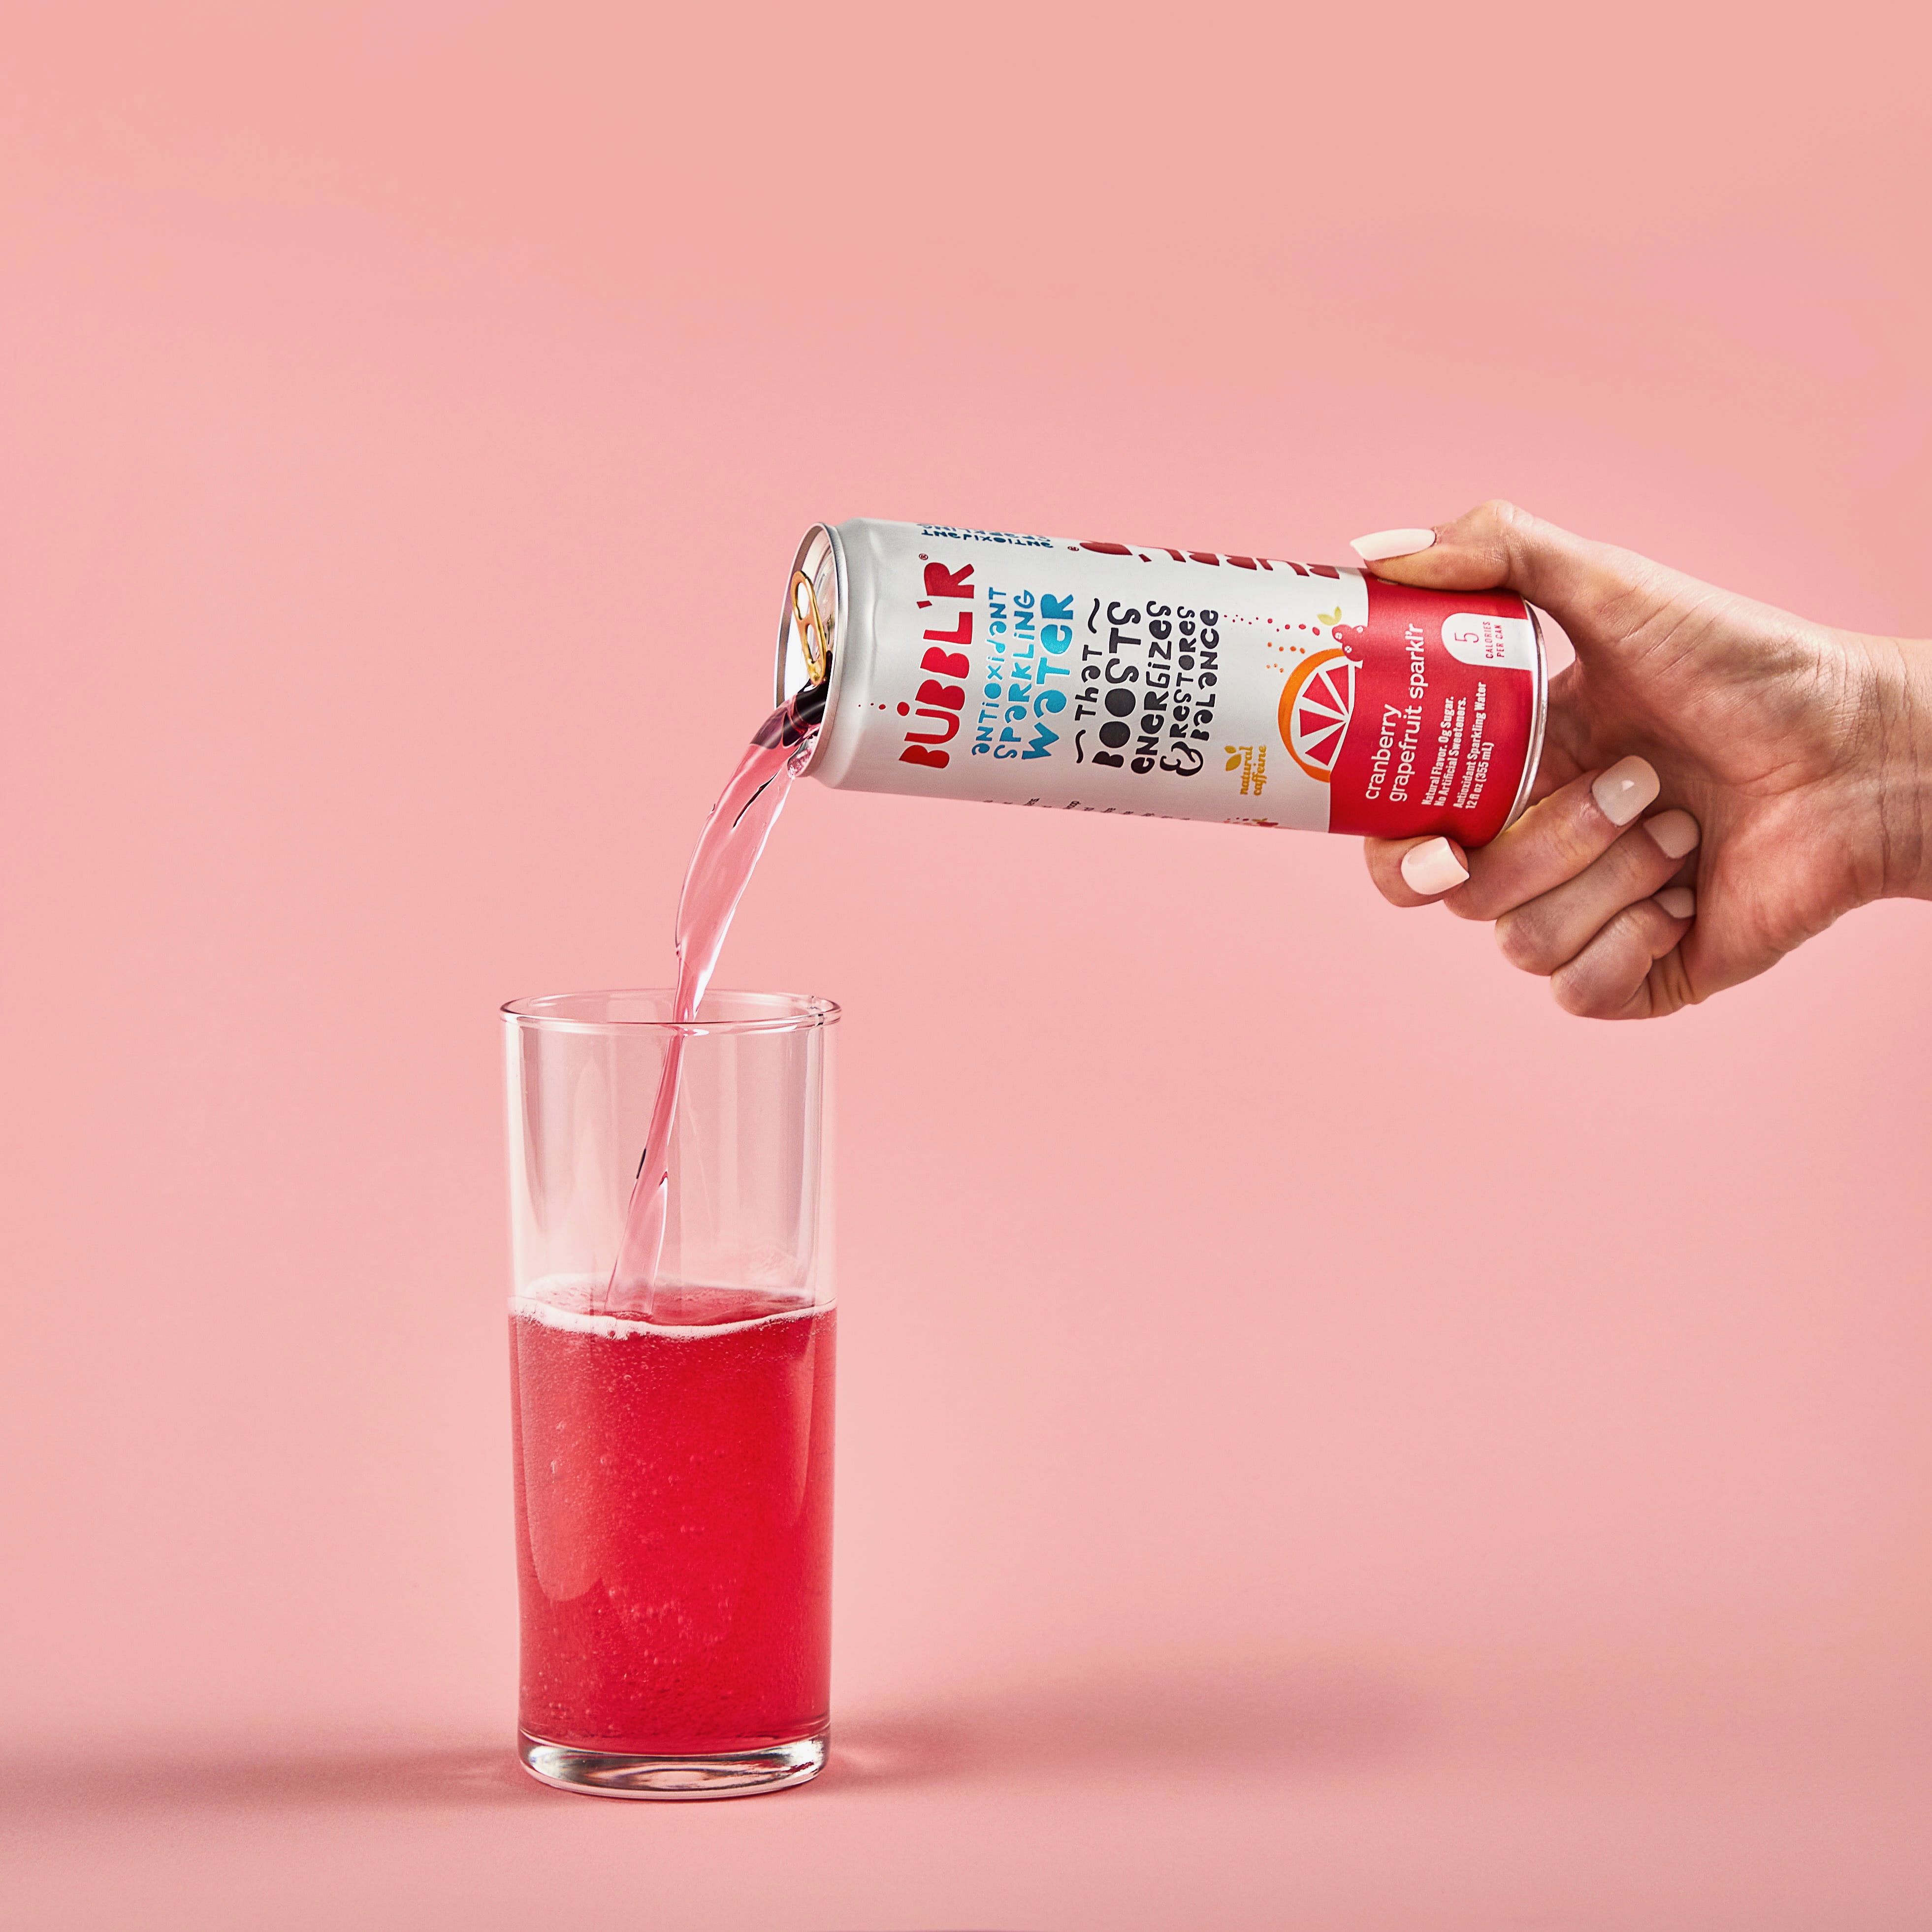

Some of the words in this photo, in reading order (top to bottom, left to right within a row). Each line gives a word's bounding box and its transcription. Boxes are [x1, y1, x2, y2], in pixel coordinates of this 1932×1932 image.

[1454, 632, 1479, 644] 5
[1482, 621, 1493, 659] CALORIES
[1494, 624, 1504, 640] CAN
[1496, 643, 1505, 658] PER
[1405, 623, 1428, 700] sparkl'r
[1092, 601, 1141, 768] BOOSTS
[1474, 682, 1486, 710] Water
[1449, 697, 1467, 757] Sweeteners.
[1467, 712, 1486, 760] Sparkling
[1365, 704, 1402, 800] cranberry
[1389, 705, 1423, 803] grapefruit
[1421, 776, 1441, 805] Natural
[1431, 745, 1448, 775] Flavor.
[1440, 696, 1455, 729] Sugar.
[1481, 742, 1495, 761] mL)
[1239, 745, 1253, 795] natural
[1252, 744, 1267, 796] caffeine
[1439, 758, 1458, 796] Artificial
[1453, 761, 1476, 808] Antioxidant
[1474, 783, 1483, 793] oz
[1475, 761, 1489, 782] (355
[1433, 796, 1446, 806] No
[1465, 801, 1478, 809] 12
